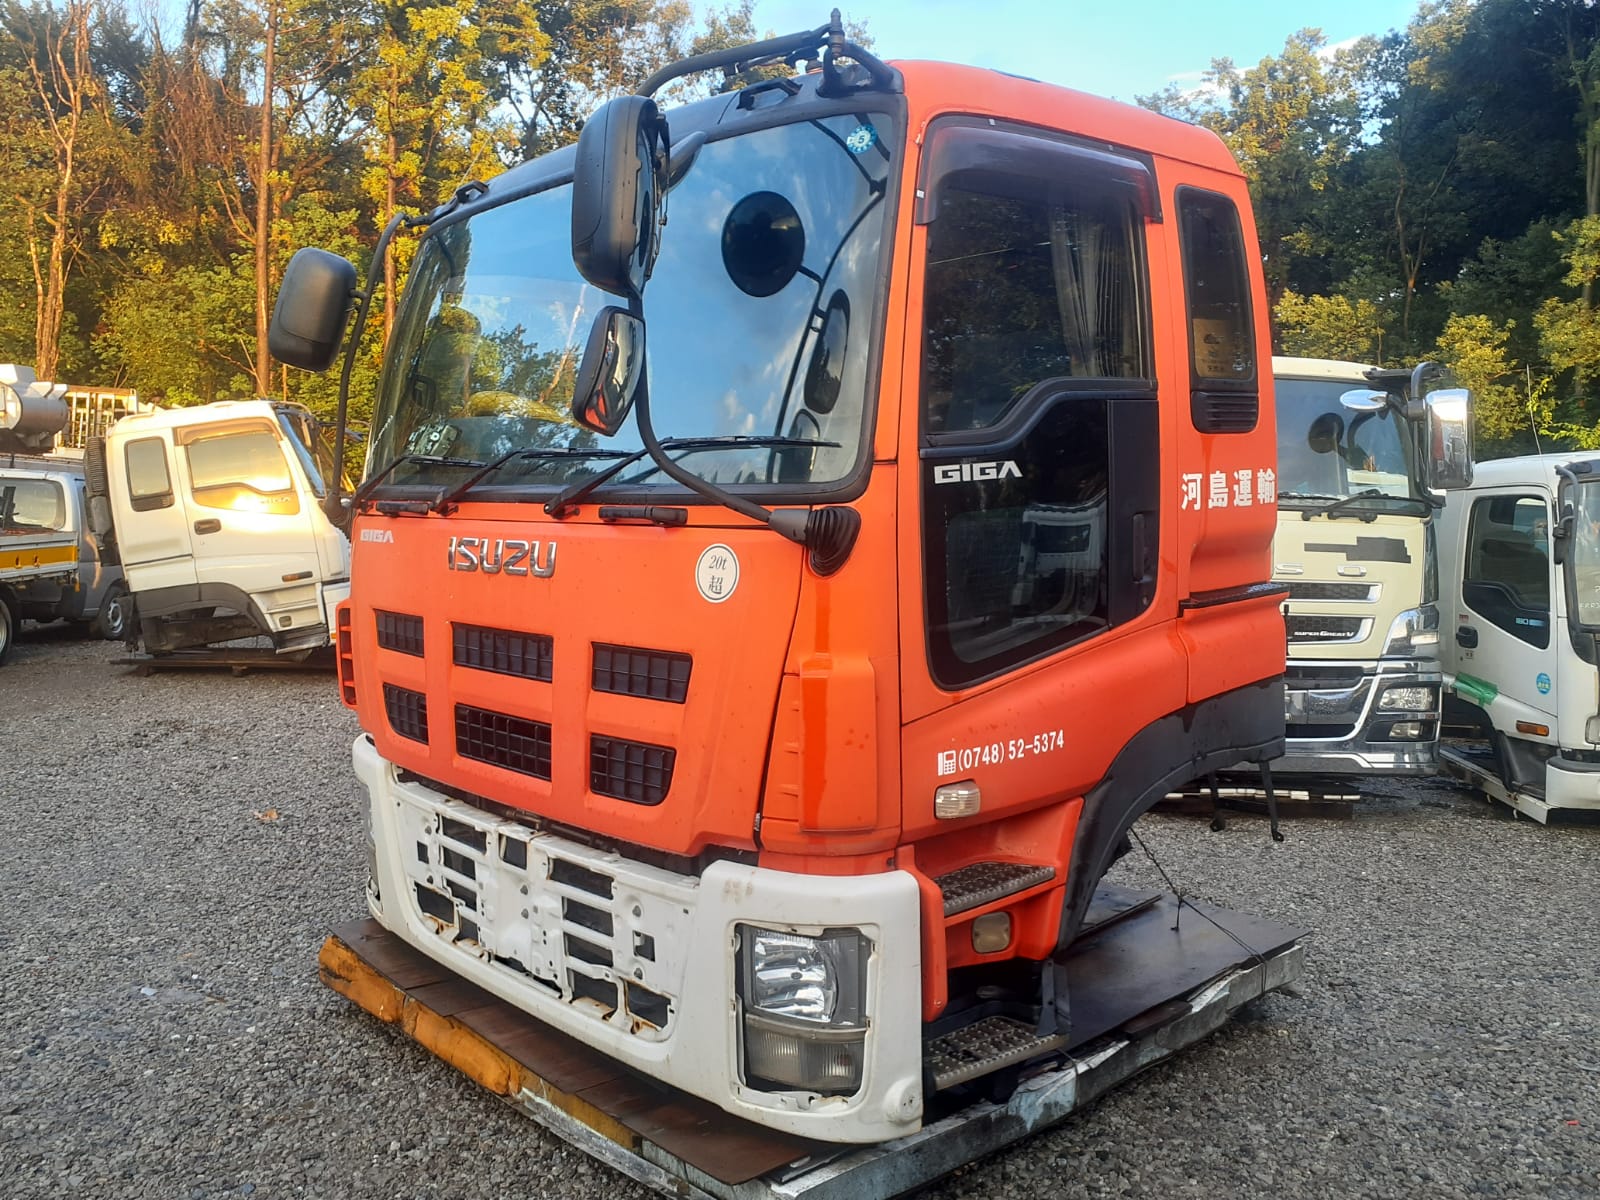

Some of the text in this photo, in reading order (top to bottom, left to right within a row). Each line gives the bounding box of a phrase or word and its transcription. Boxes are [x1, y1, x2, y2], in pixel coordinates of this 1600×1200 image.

[857, 134, 866, 145] 5
[933, 460, 1023, 484] GIGA
[1181, 467, 1275, 511] 河島運輸
[360, 528, 394, 544] GIGA
[448, 536, 557, 578] ISUZU
[708, 554, 728, 571] 20t
[958, 729, 1065, 771] (0748) 52-5374
